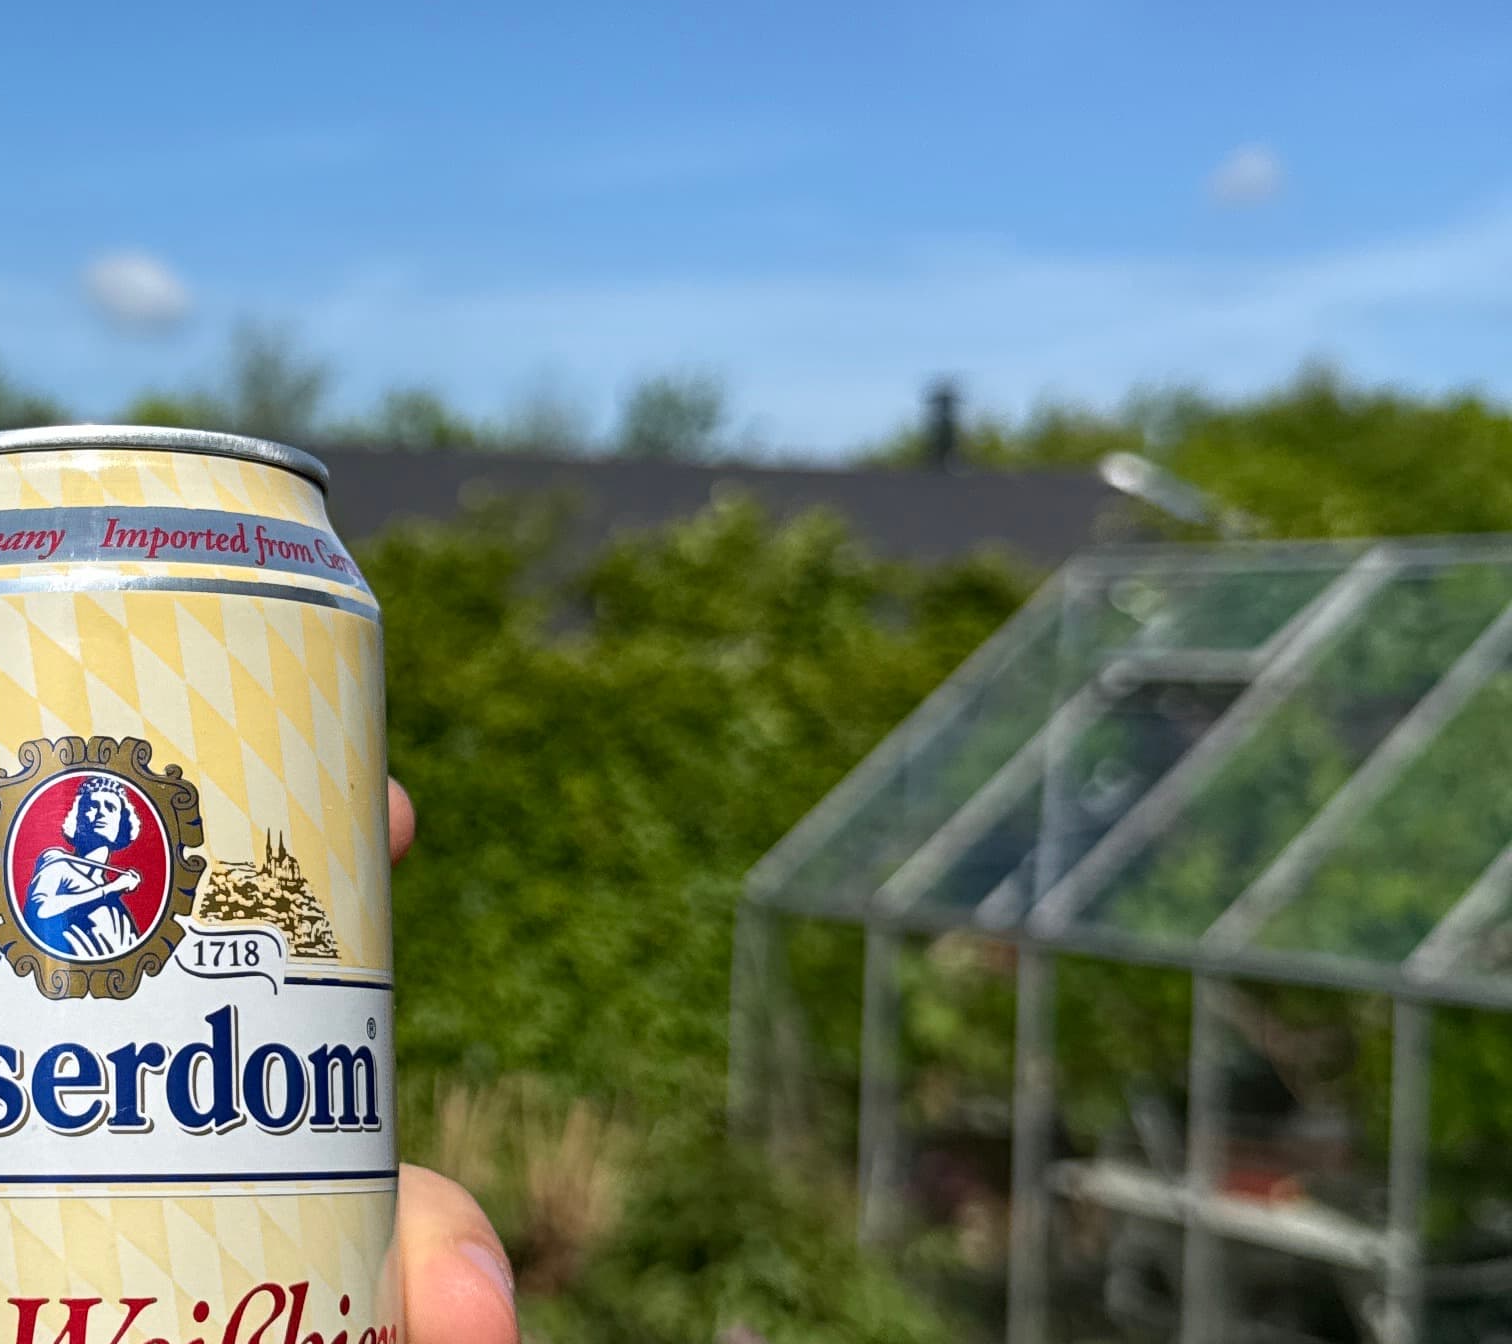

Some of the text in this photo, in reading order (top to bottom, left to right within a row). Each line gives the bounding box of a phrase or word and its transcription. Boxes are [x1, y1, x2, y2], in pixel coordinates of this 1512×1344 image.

[100, 518, 249, 558] Imported
[254, 524, 315, 566] from
[193, 939, 260, 968] 1718
